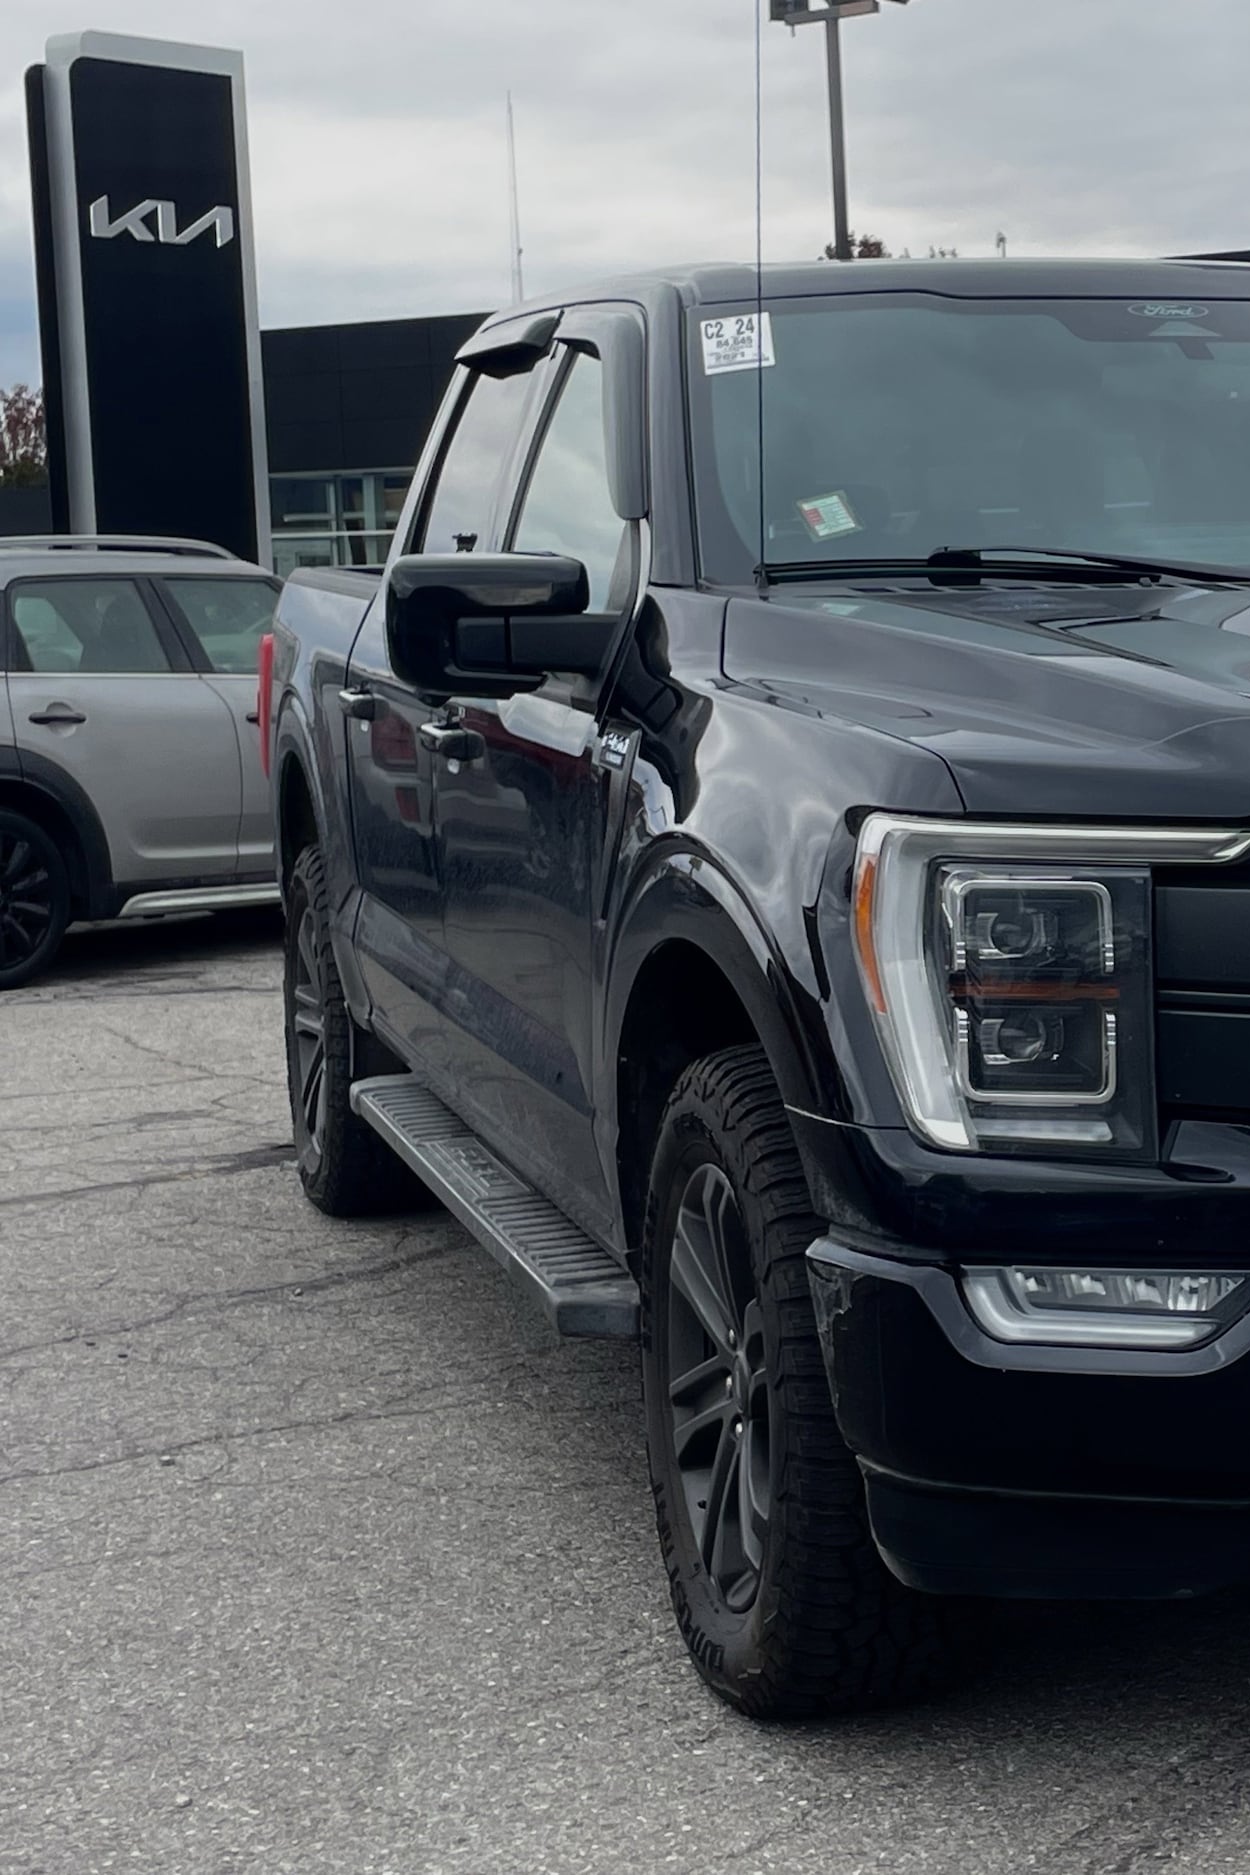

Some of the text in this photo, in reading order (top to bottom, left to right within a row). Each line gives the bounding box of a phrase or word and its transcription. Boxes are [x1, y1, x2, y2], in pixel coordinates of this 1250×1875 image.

[90, 194, 234, 248] KIA
[1143, 303, 1193, 317] Ford
[704, 317, 755, 340] C2 24
